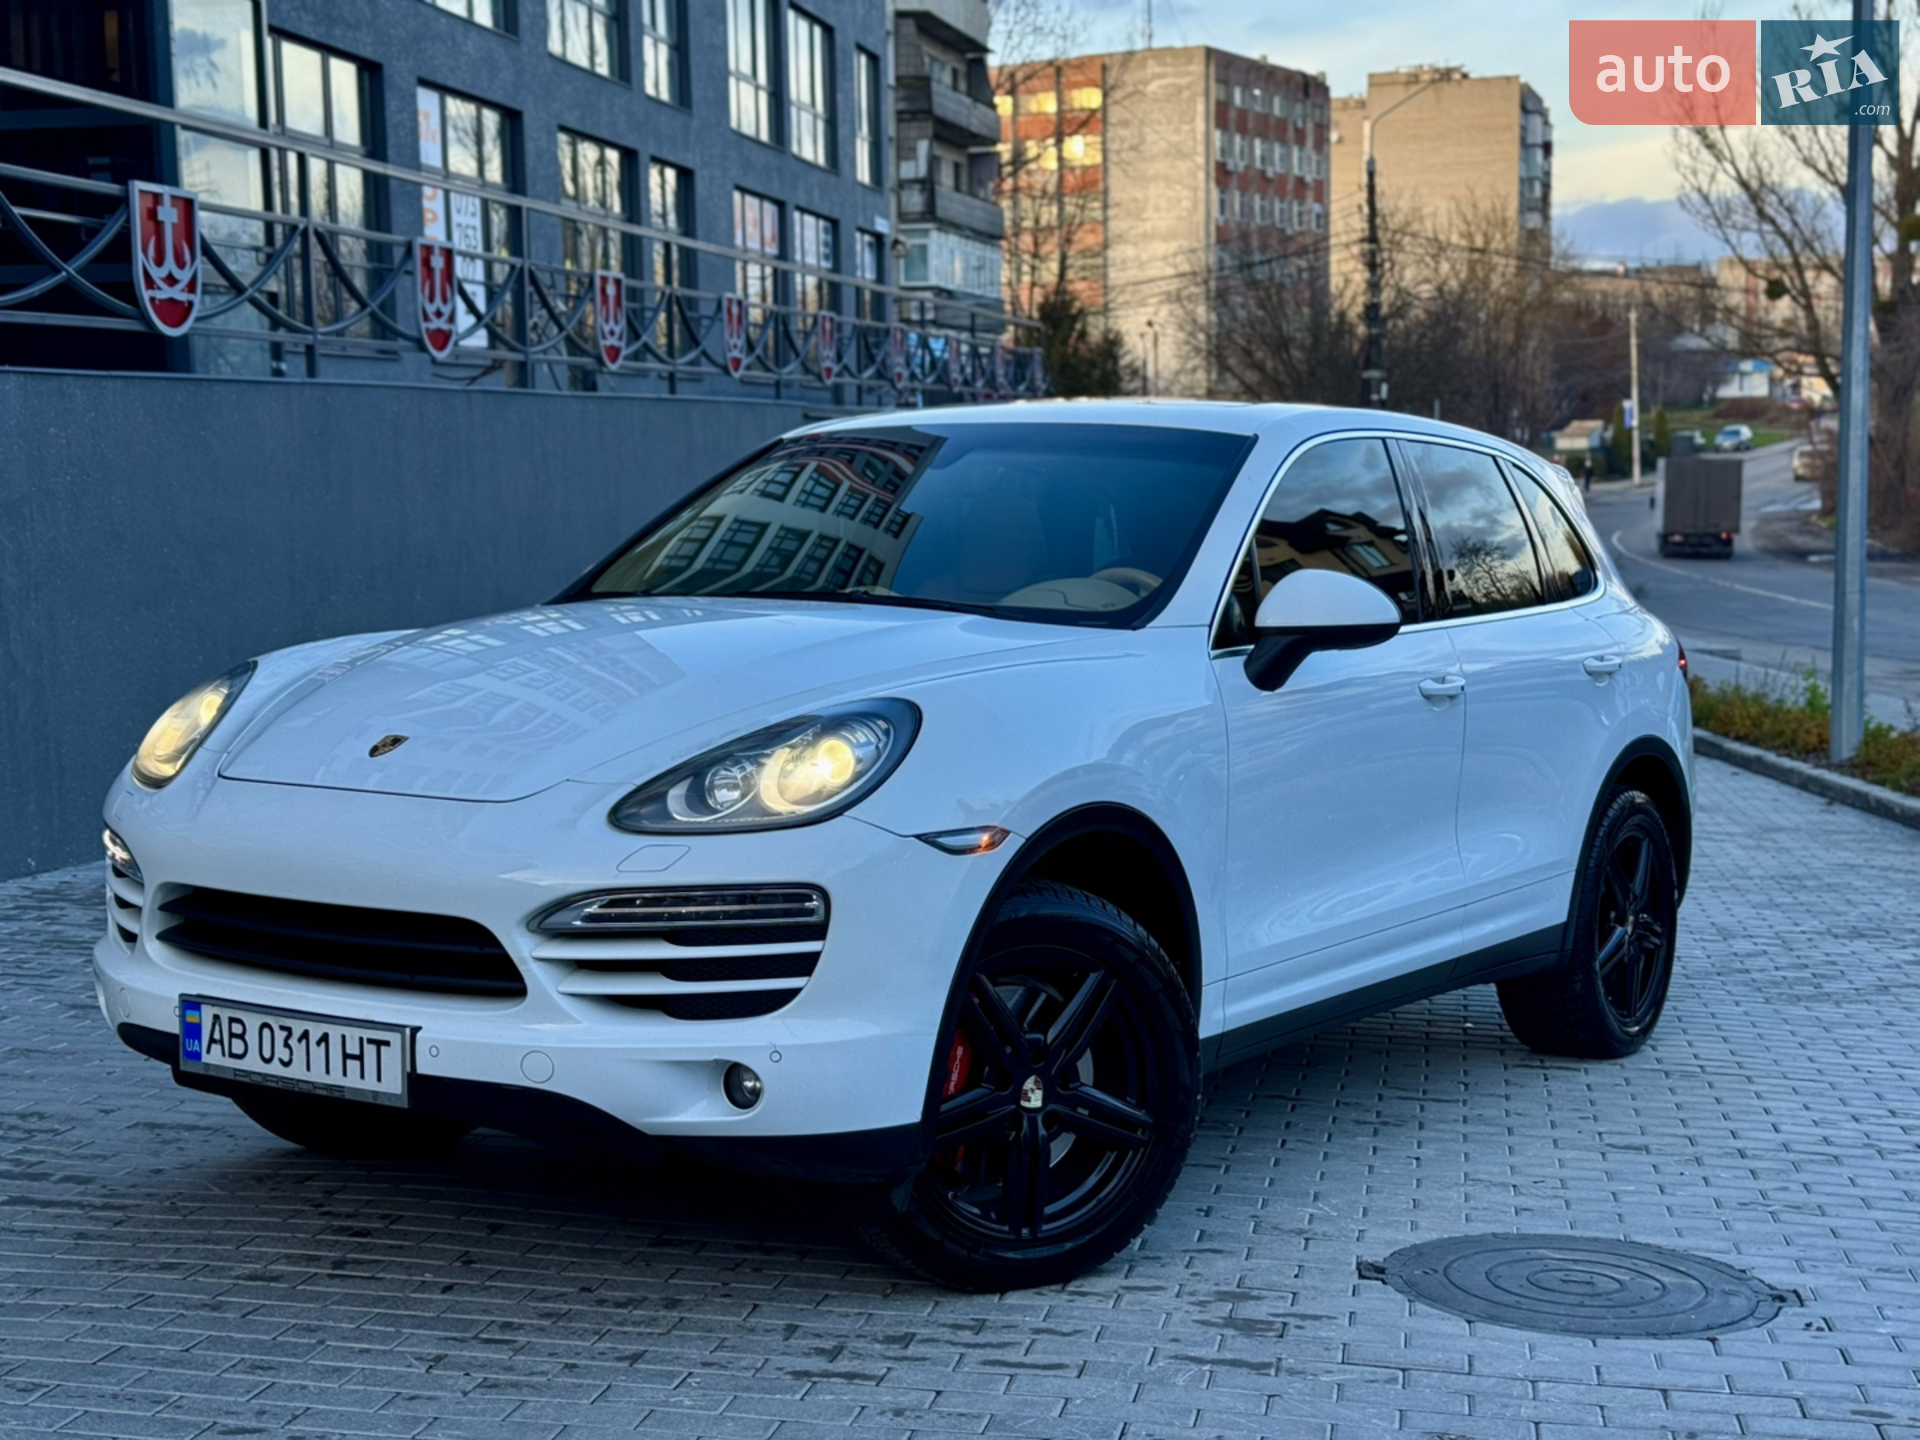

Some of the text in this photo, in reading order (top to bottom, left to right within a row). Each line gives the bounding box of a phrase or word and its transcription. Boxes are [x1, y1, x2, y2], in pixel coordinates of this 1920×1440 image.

[185, 1037, 201, 1052] UA
[205, 1013, 391, 1083] AB 0311 HT
[233, 1068, 346, 1098] PORSCHE
